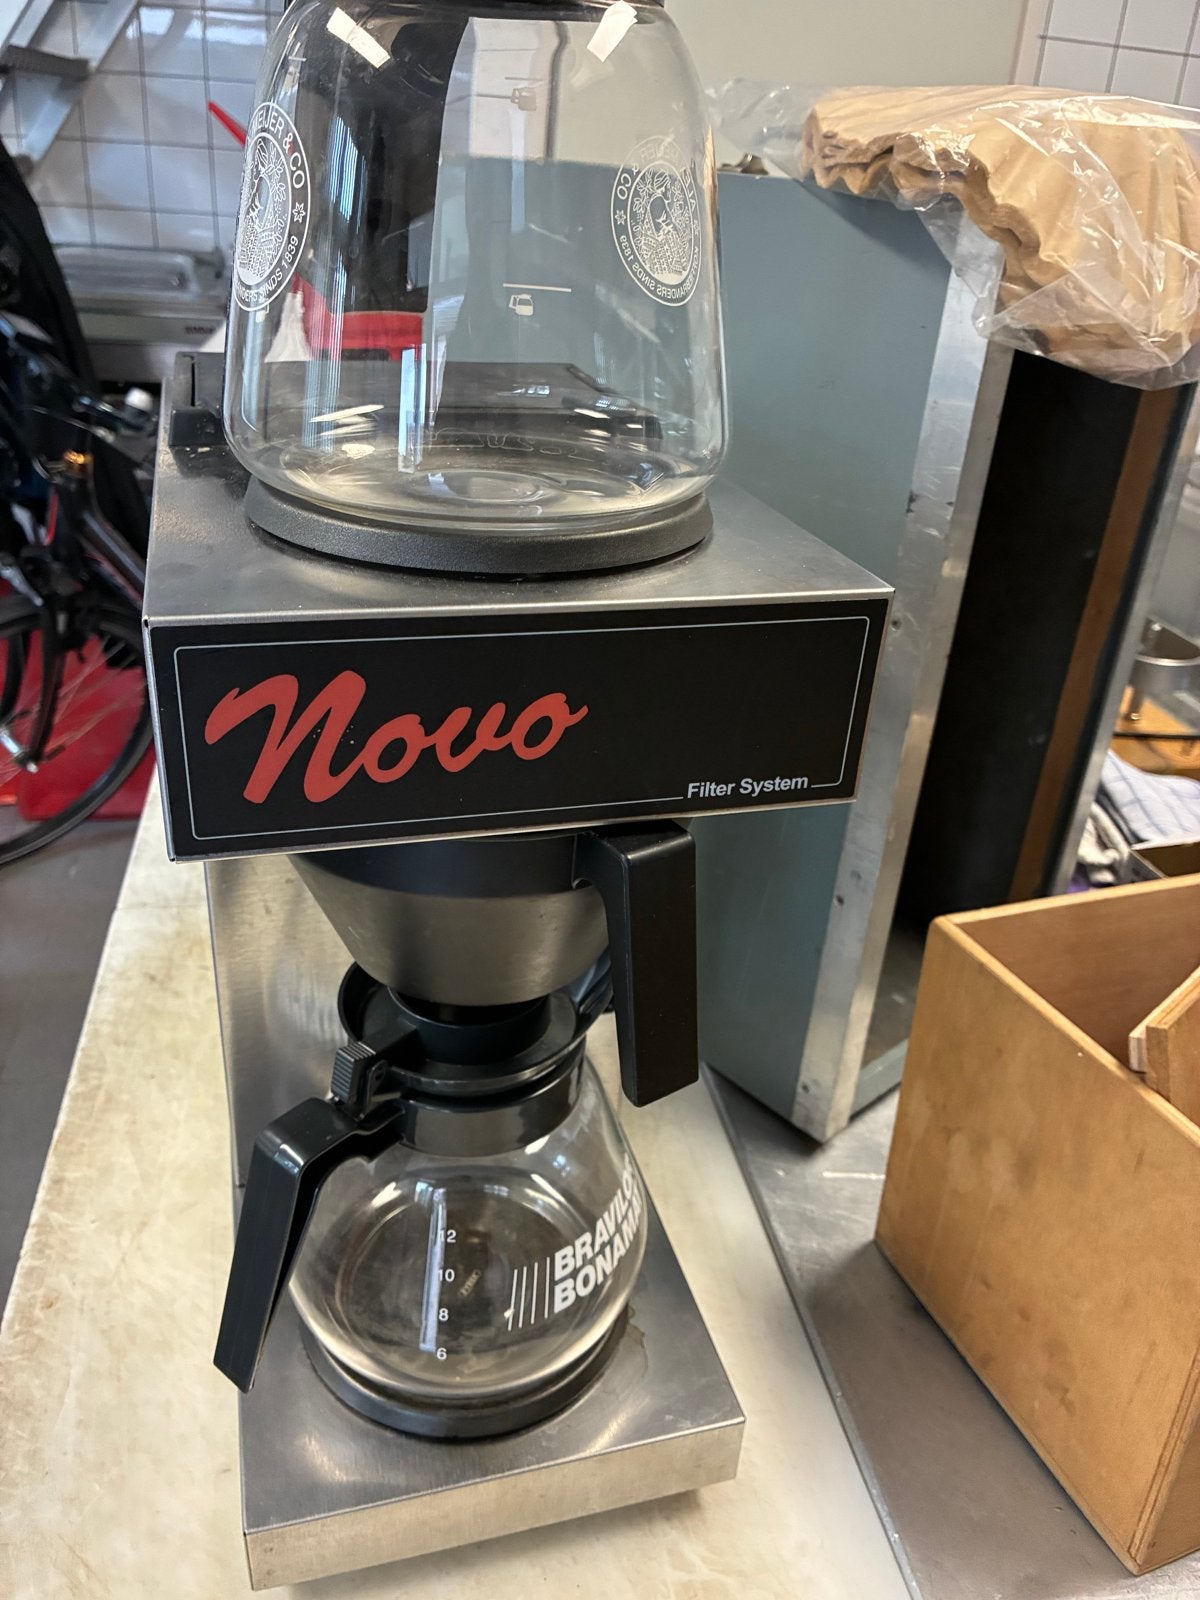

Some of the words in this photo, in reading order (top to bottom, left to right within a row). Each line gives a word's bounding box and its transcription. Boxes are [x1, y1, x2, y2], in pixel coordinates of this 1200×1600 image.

[282, 132, 293, 153] &
[289, 151, 306, 189] CO
[281, 234, 299, 269] 1839
[204, 669, 589, 805] Novo
[687, 779, 736, 799] Filter
[739, 775, 809, 797] System
[440, 1229, 457, 1243] 12
[438, 1268, 456, 1282] 10
[438, 1307, 449, 1322] 8
[436, 1346, 448, 1360] 6
